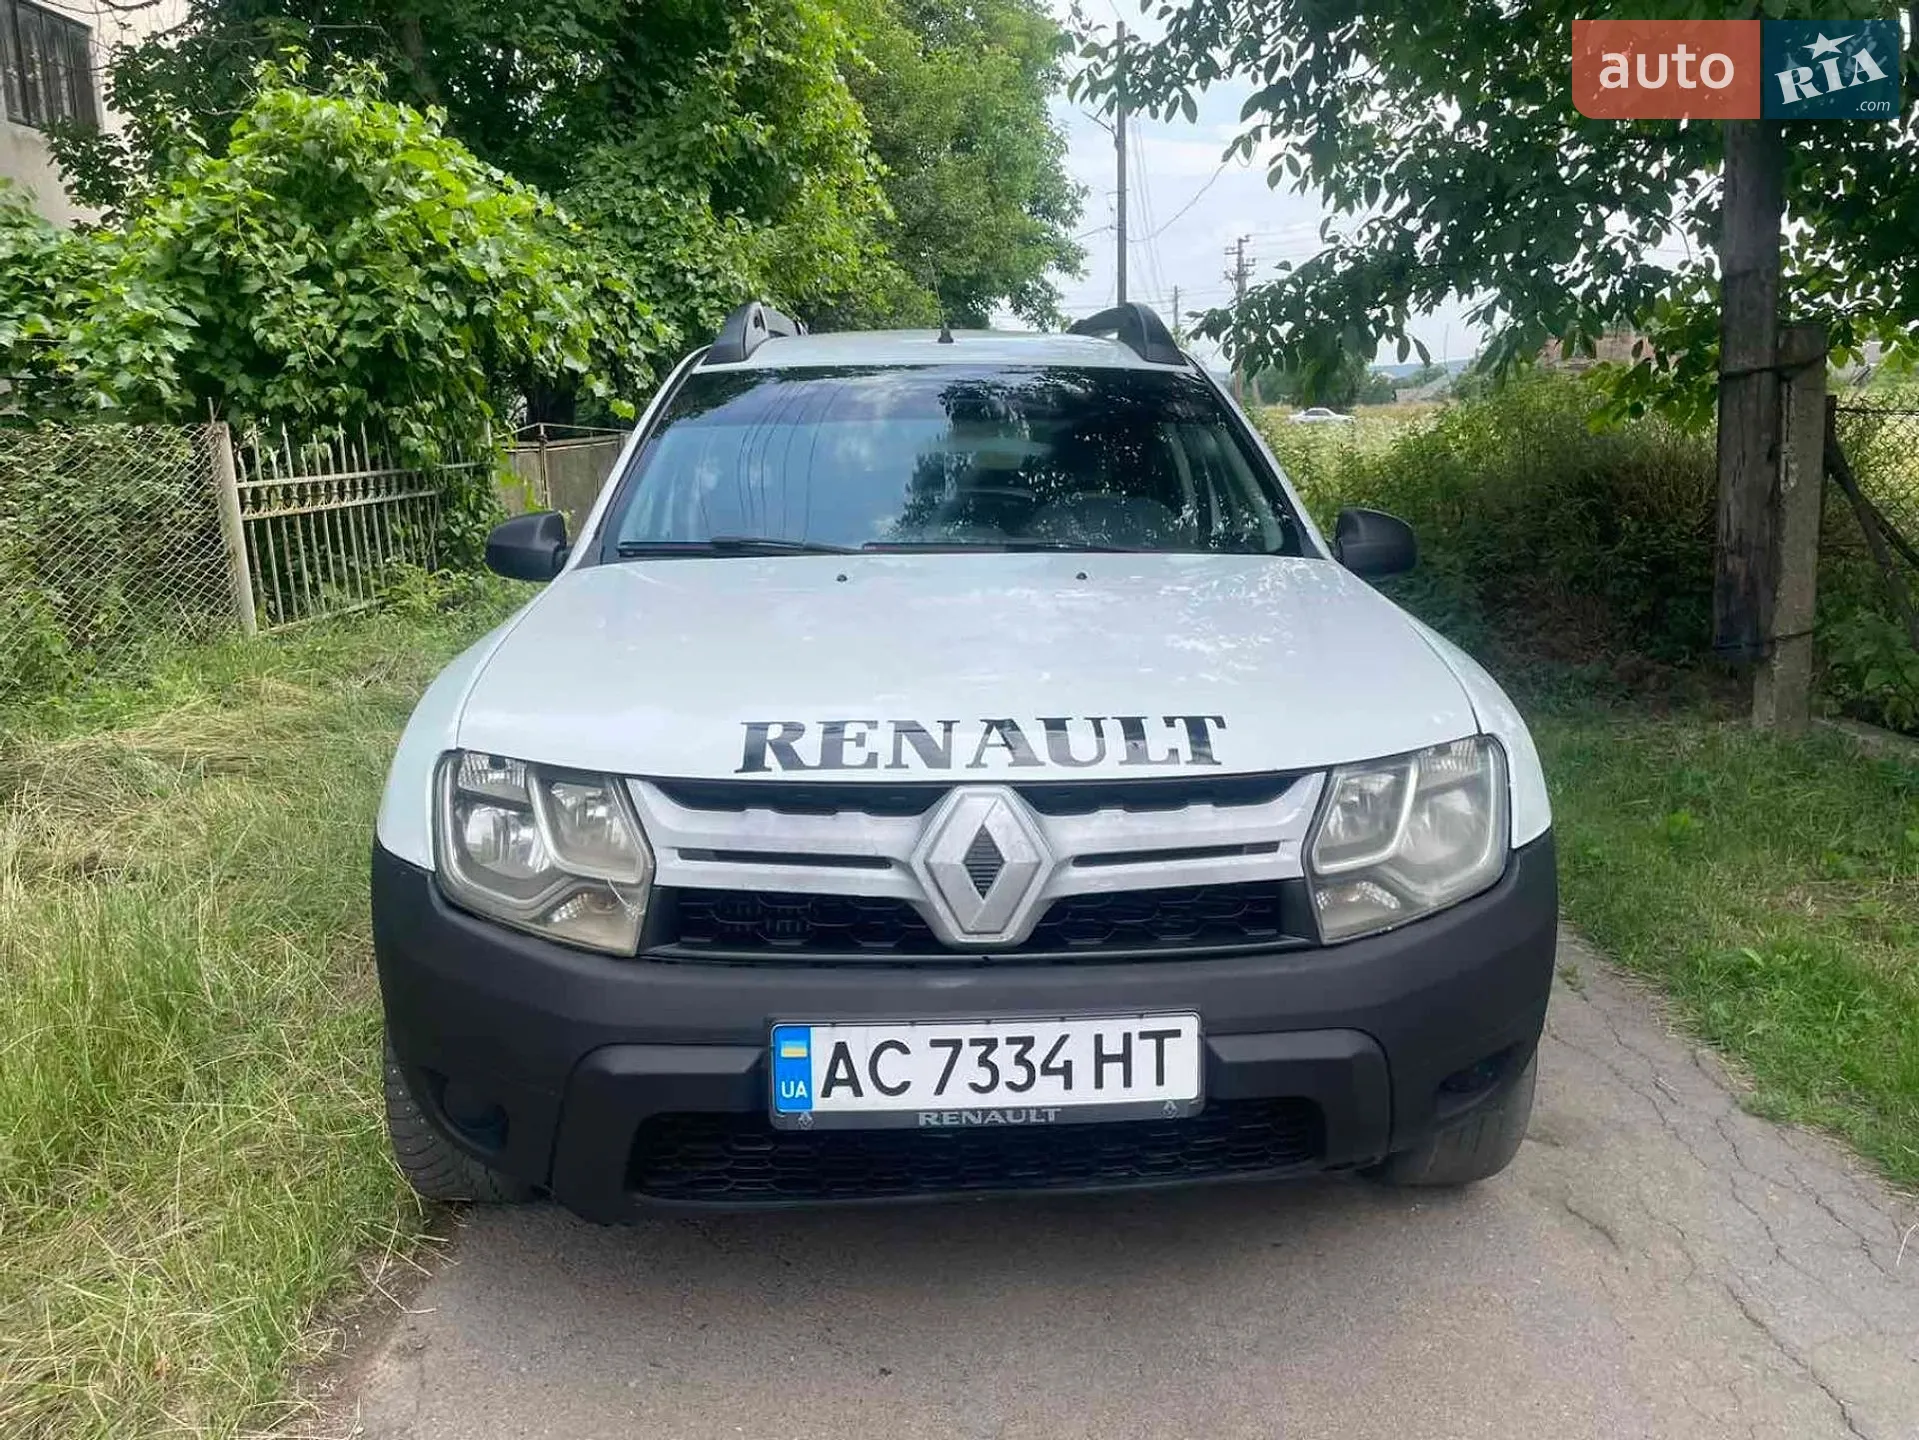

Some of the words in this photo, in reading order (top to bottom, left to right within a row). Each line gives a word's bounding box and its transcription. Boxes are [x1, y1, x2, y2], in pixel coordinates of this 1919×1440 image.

[734, 715, 1228, 773] RENAULT
[820, 1039, 911, 1098] AC
[929, 1033, 1073, 1096] 7334
[1094, 1029, 1182, 1089] HT
[781, 1081, 808, 1099] UA
[918, 1107, 1062, 1127] RENAULT
